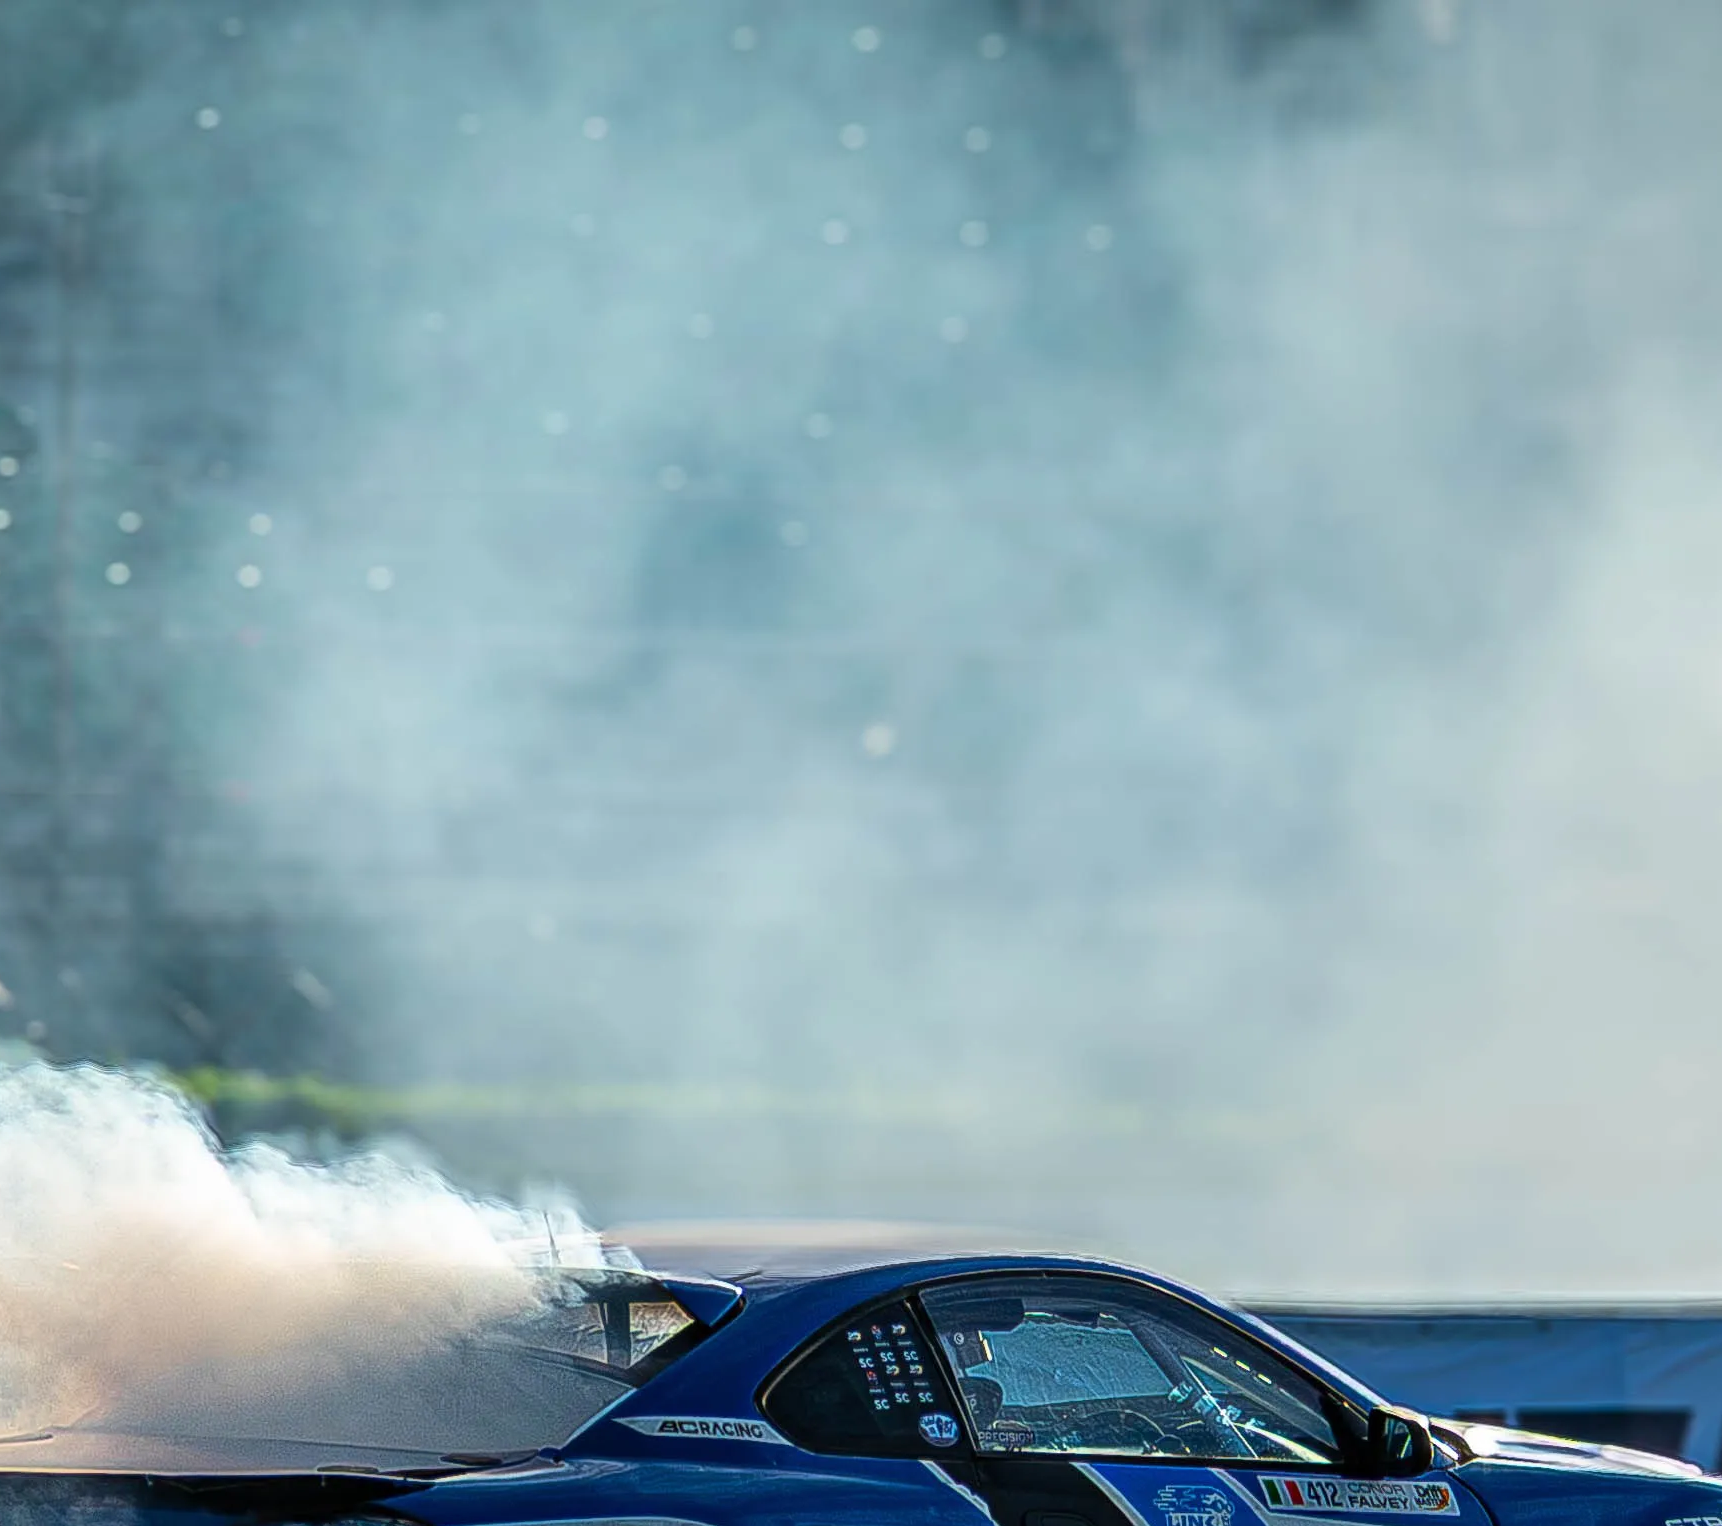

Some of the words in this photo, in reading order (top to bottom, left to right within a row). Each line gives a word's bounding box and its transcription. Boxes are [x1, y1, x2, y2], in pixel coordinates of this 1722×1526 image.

[1308, 1480, 1343, 1507] 412
[1347, 1482, 1405, 1495] CONOR
[1349, 1495, 1409, 1510] FALVEY
